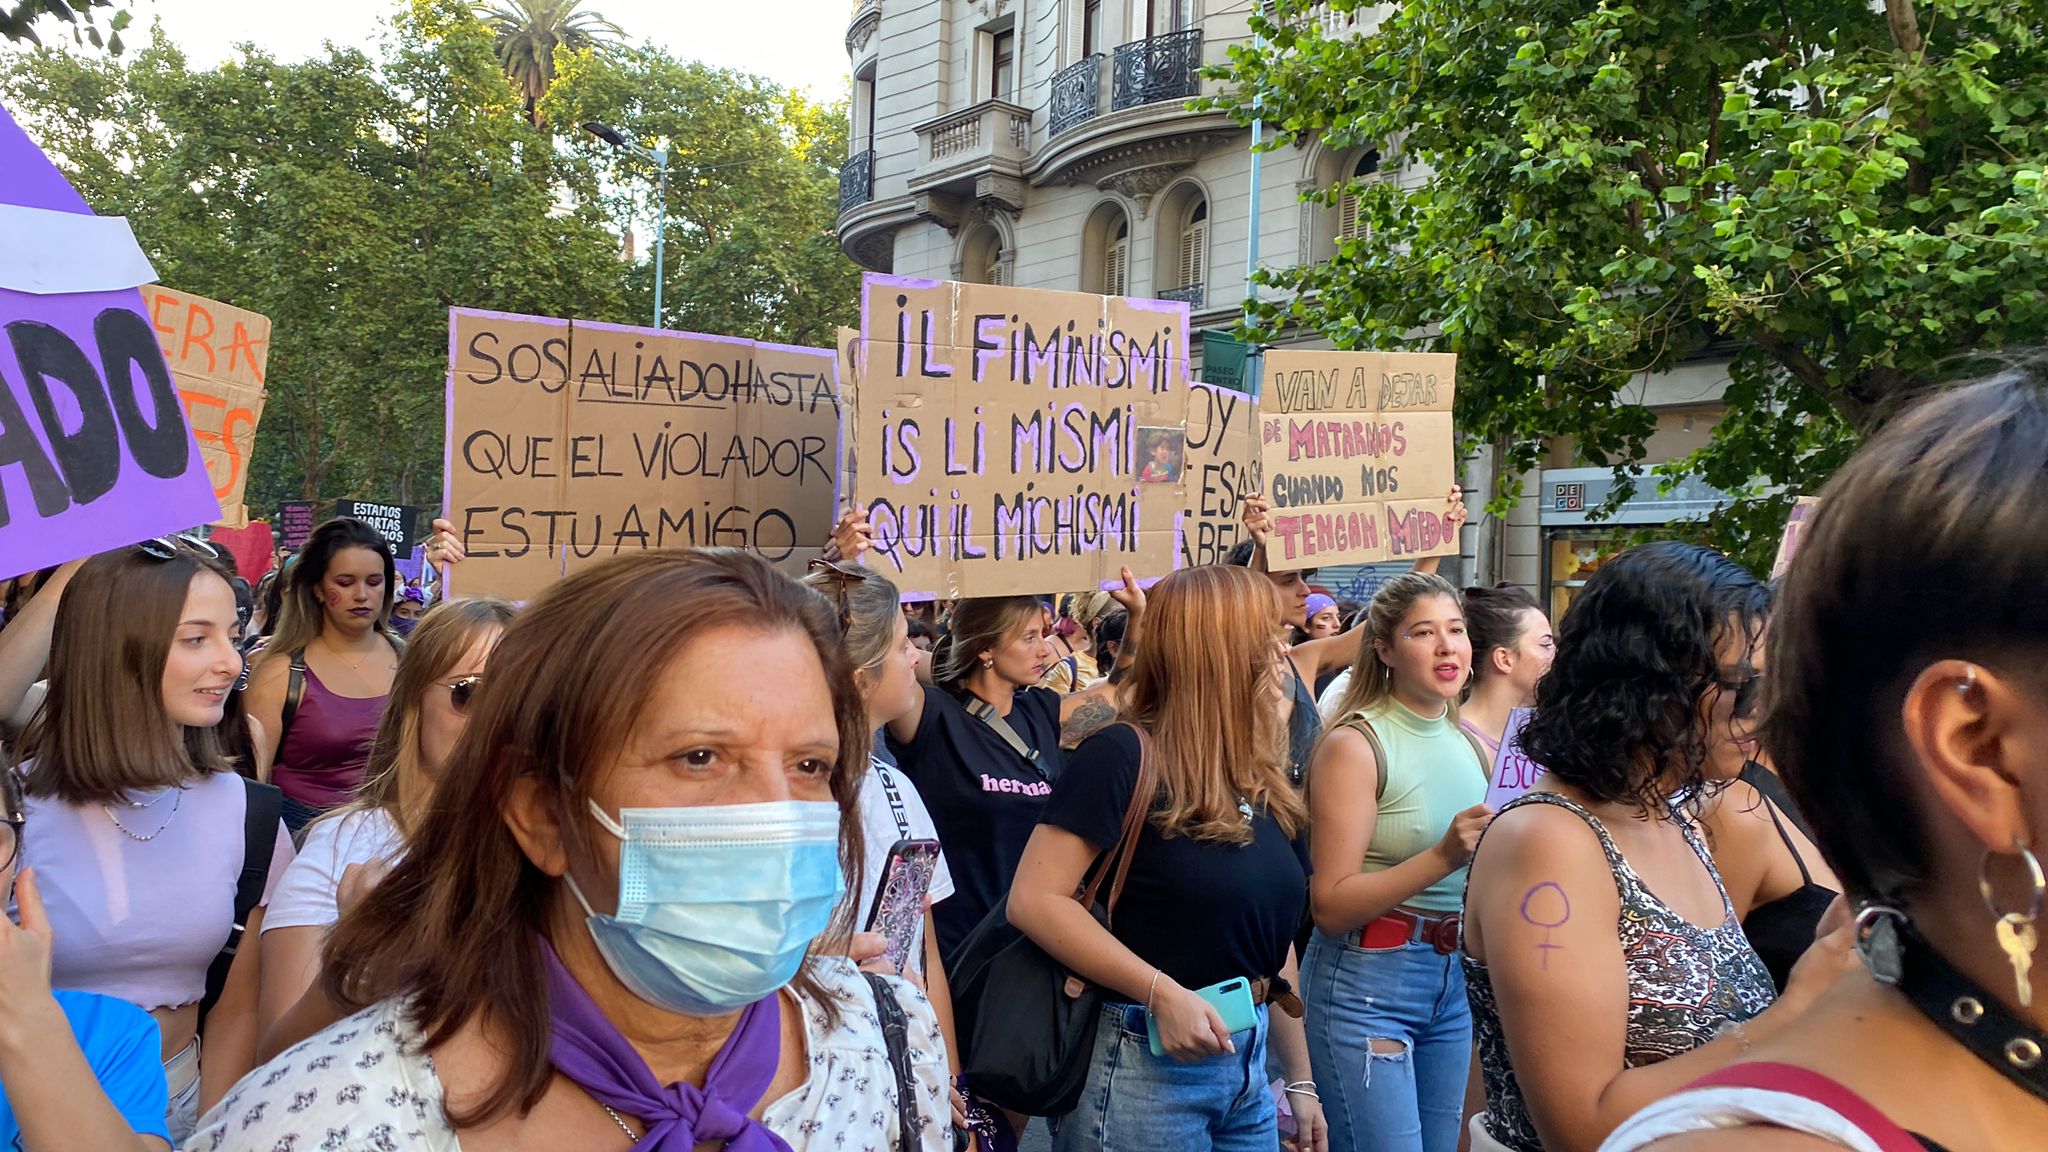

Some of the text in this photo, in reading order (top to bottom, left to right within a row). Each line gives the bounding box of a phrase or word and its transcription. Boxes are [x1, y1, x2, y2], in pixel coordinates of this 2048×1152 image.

[143, 294, 265, 385] ERA
[466, 331, 569, 394] SOS
[1204, 375, 1241, 387] CENTRO
[1205, 365, 1235, 376] PASEO
[1275, 366, 1438, 414] VAN A DEJAR
[462, 428, 557, 480] QUE
[571, 436, 623, 479] EL
[1263, 418, 1407, 461] DE MATARNOS
[1272, 463, 1399, 508] CUANDO NOS
[352, 502, 402, 519] ESTAMOS
[1274, 511, 1379, 560] TENGAN
